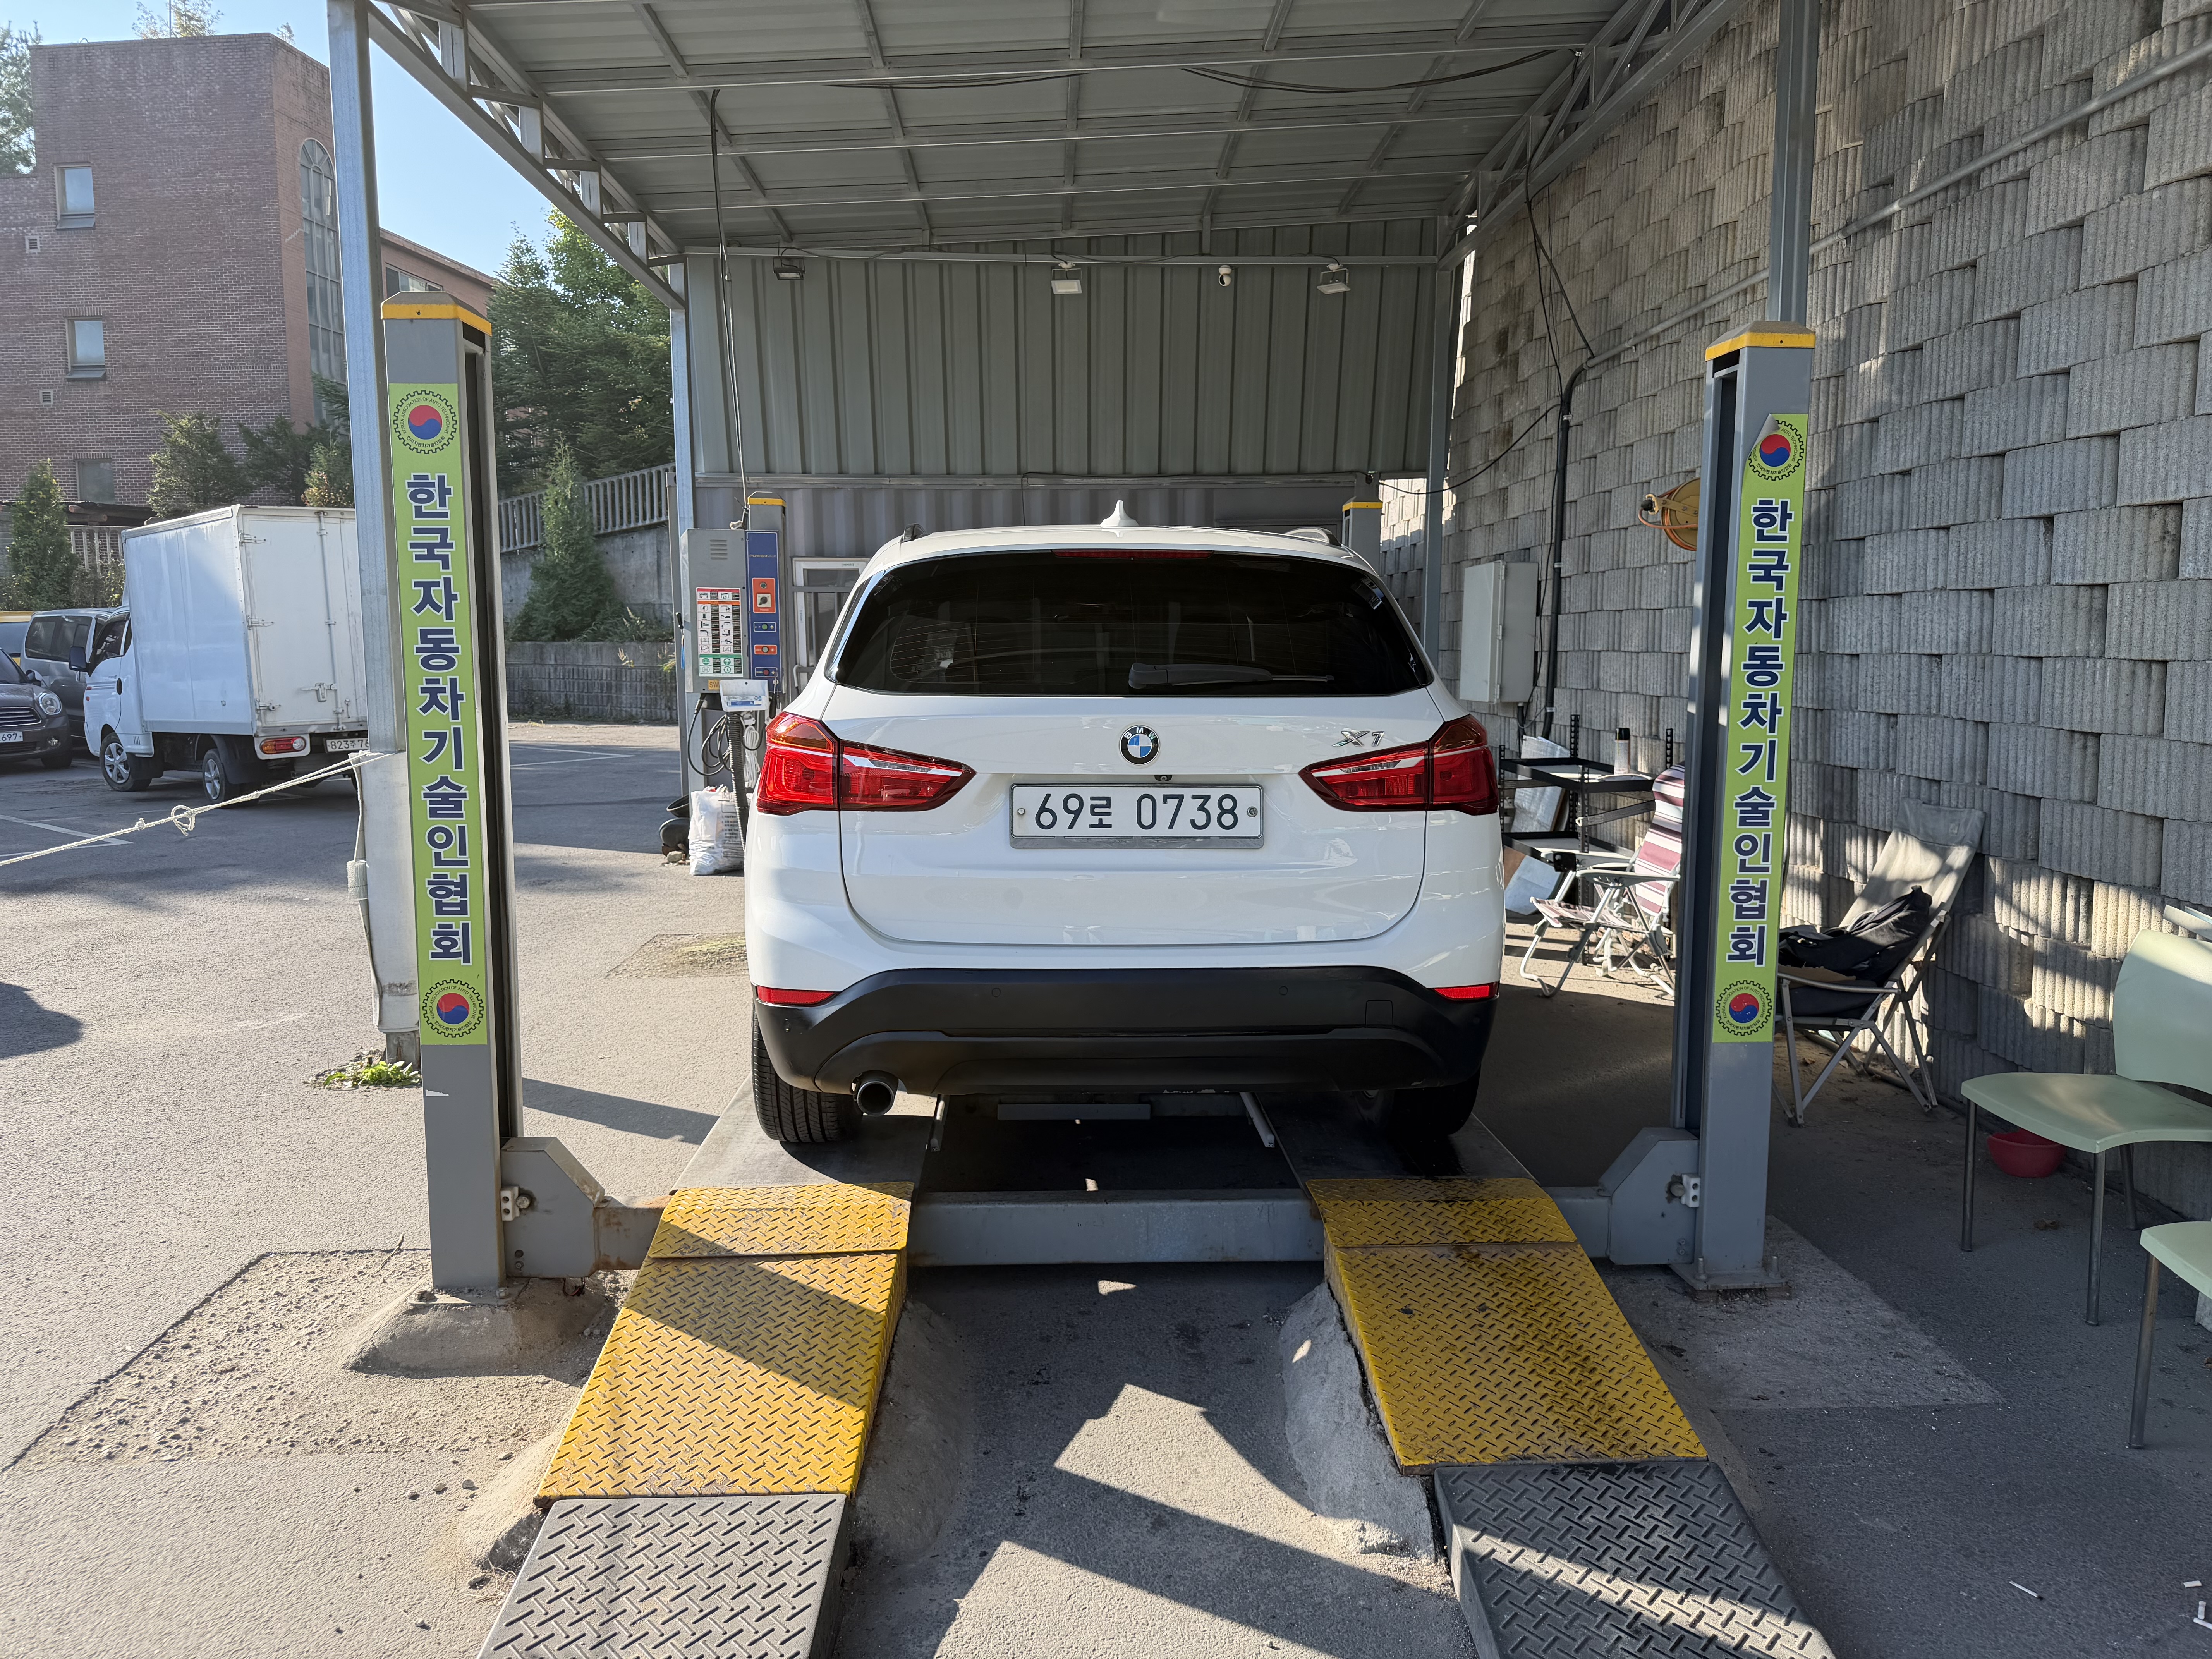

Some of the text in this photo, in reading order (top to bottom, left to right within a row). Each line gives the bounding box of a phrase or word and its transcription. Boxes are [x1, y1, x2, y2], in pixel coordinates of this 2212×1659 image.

[401, 397, 422, 418] ASSOCIATION
[429, 399, 441, 407] AUTO
[1781, 428, 1791, 436] AUTO
[406, 472, 473, 965] 한국자동차기술인협회
[0, 733, 17, 741] 697
[1124, 727, 1156, 740] BMW
[1332, 731, 1385, 747] X1
[1726, 498, 1794, 967] 한국자동차기술인협회
[1035, 793, 1238, 830] 69로 0738
[457, 987, 469, 995] AUTO
